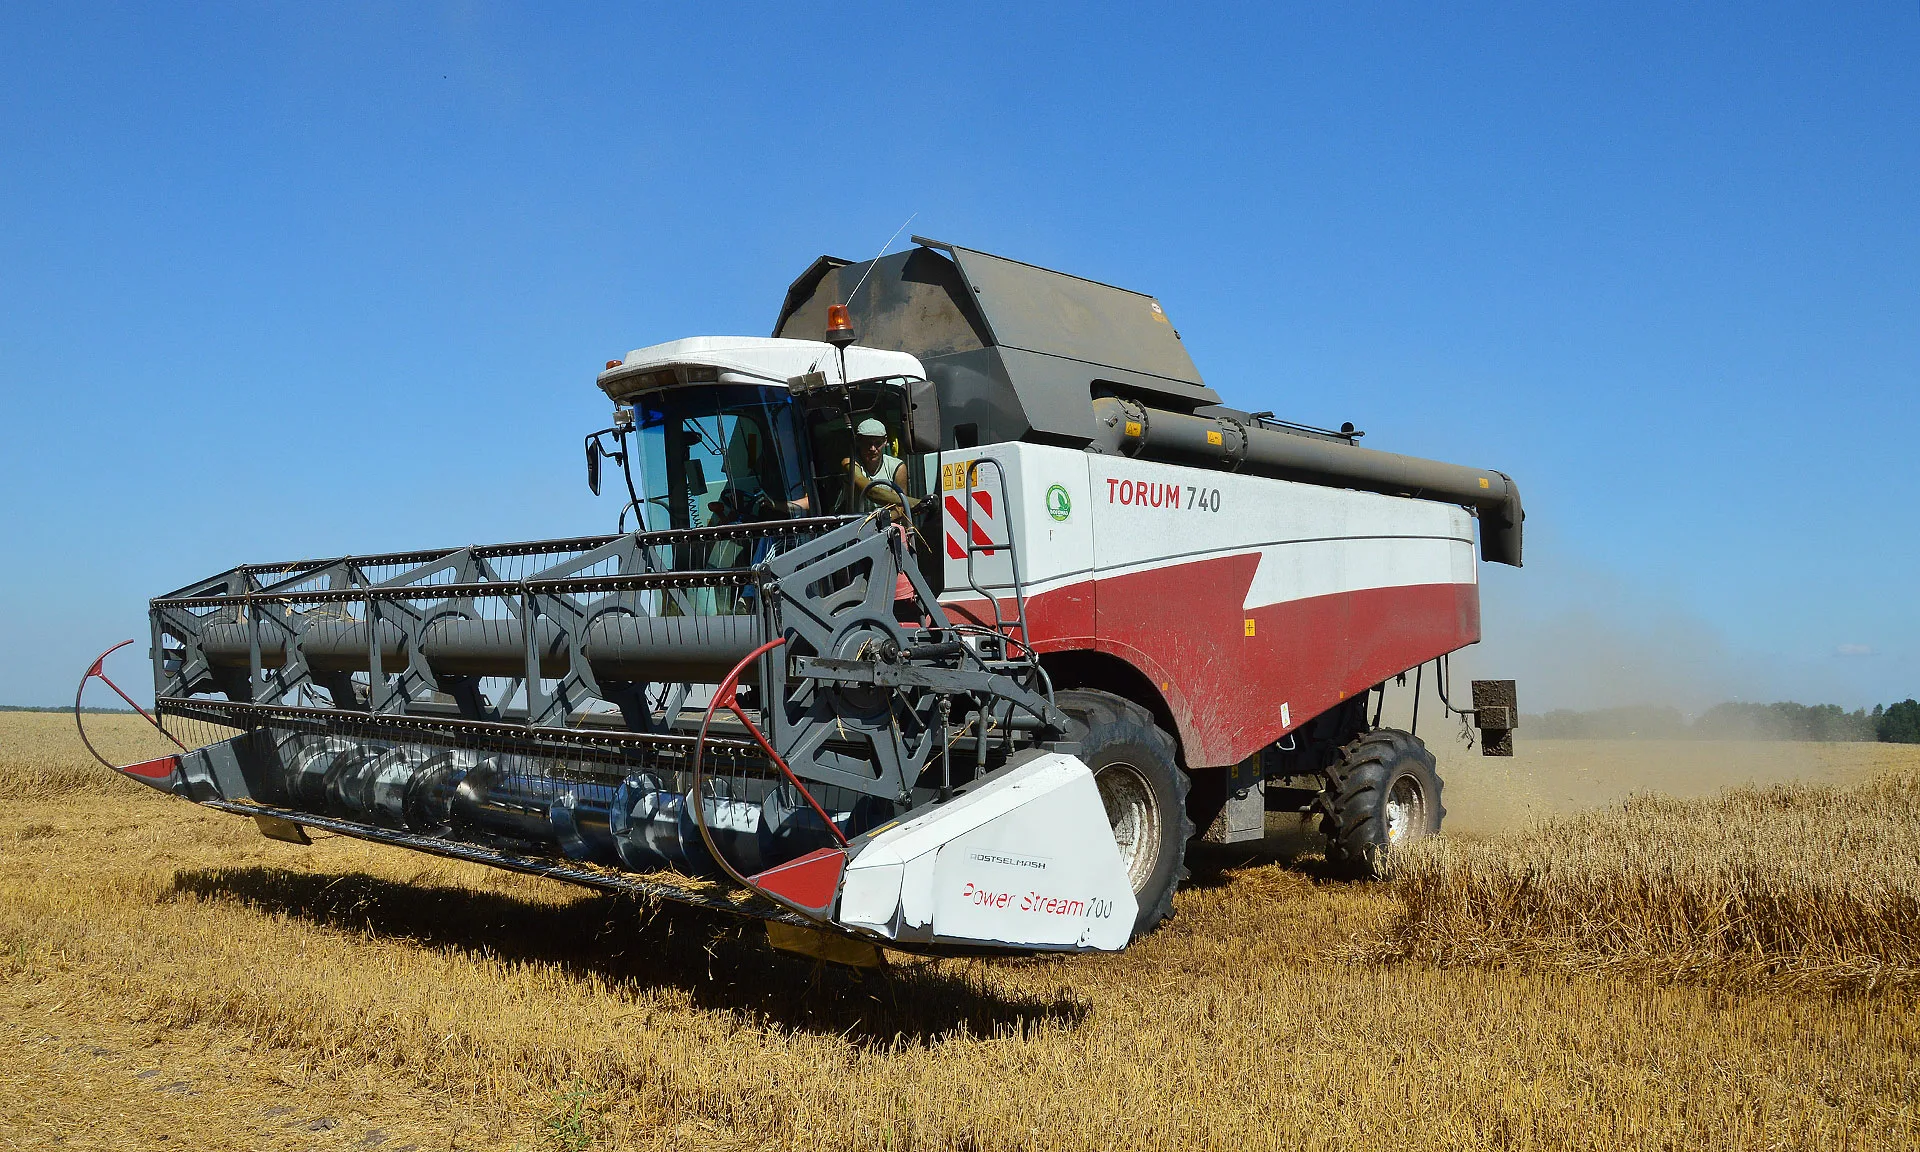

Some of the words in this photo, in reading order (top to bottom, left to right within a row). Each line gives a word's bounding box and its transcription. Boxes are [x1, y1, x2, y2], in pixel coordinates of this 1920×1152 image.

[1106, 478, 1180, 509] TORUM
[1187, 486, 1220, 512] 740
[963, 882, 1016, 909] Power
[1020, 891, 1084, 917] Stream
[1086, 897, 1113, 919] 700
